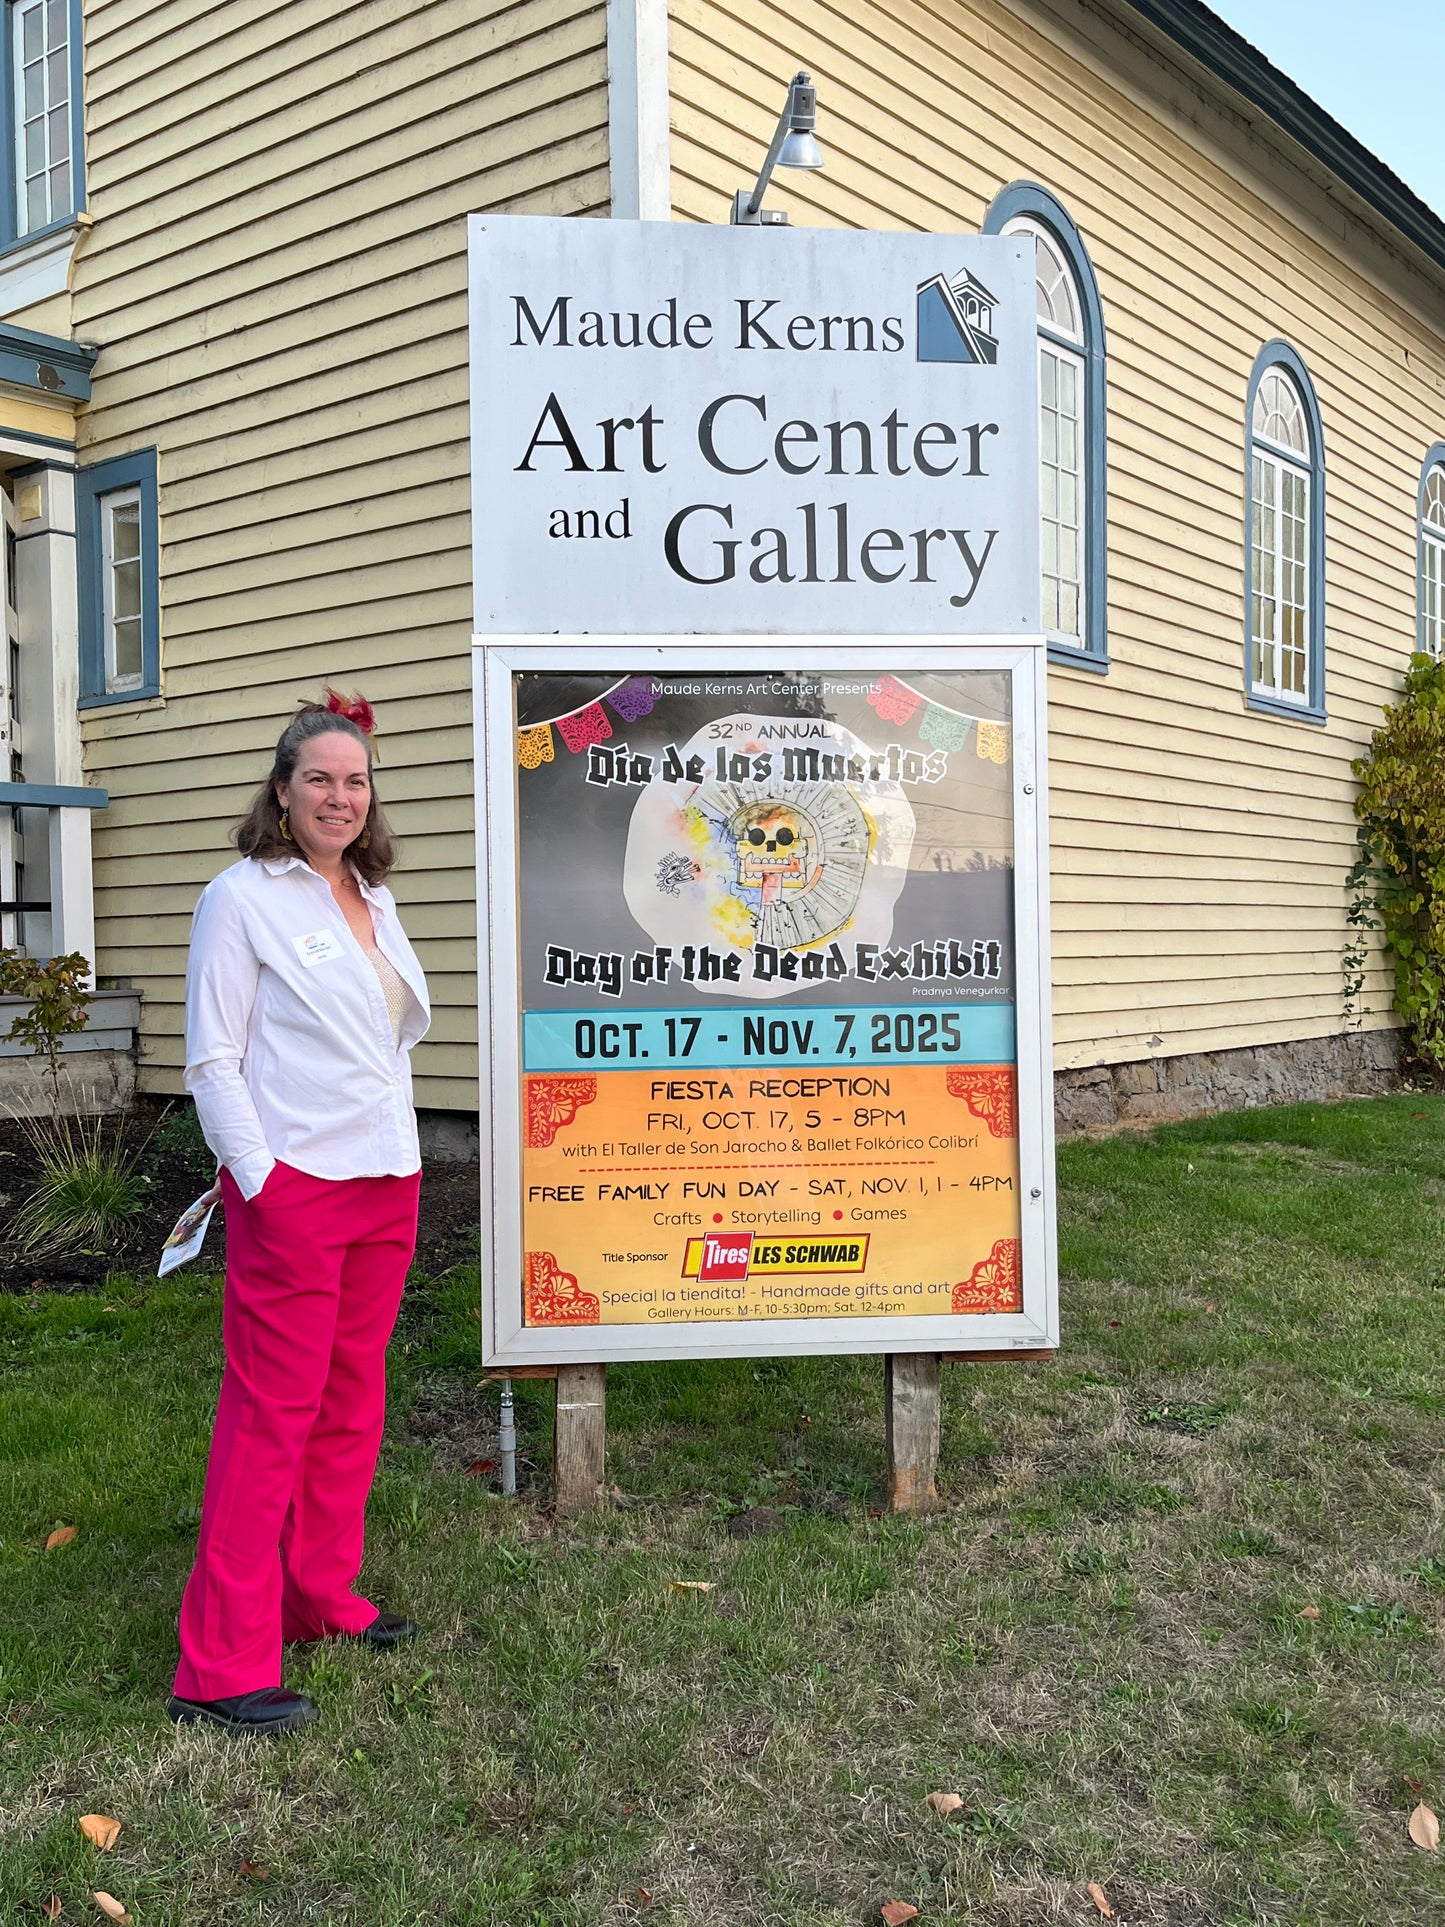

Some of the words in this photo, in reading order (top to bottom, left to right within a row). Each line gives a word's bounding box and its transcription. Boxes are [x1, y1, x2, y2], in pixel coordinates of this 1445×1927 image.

[509, 294, 714, 351] Maude
[734, 299, 905, 353] Kerns
[513, 391, 667, 474] Art
[698, 393, 999, 477] Center
[548, 497, 633, 540] and
[664, 502, 999, 608] Gallery
[651, 682, 701, 695] Maude
[705, 682, 743, 695] Kerns
[746, 682, 767, 695] Art
[771, 682, 819, 695] Center
[823, 682, 882, 695] Presents
[757, 723, 831, 739] ANNUAL
[585, 743, 653, 787] Día
[662, 743, 706, 786] de
[715, 745, 772, 784] los
[782, 743, 948, 785] Muertos
[544, 943, 624, 998] Day
[681, 945, 742, 984] the
[752, 942, 847, 984] Dead
[854, 937, 1002, 983] Exhibit
[912, 986, 952, 998] Pradnya
[954, 985, 1010, 997] Venegurkar
[665, 1018, 702, 1056] 17
[834, 1015, 857, 1058] 7,
[871, 1013, 961, 1053] 2025
[651, 1080, 734, 1100] FIESTA
[750, 1077, 890, 1099] RECEPTION
[769, 1110, 794, 1133] 17,
[804, 1110, 821, 1128] 5
[853, 1108, 906, 1127] 8PM
[562, 1143, 597, 1157] with
[602, 1143, 614, 1156] El
[618, 1142, 662, 1156] Taller
[665, 1141, 686, 1155] de
[690, 1141, 719, 1154] Son
[723, 1140, 787, 1153] Jarocho
[791, 1140, 803, 1152] &
[807, 1138, 851, 1151] Ballet
[856, 1136, 924, 1150] Folkórico
[928, 1134, 979, 1149] Colibrí
[529, 1185, 585, 1202] FREE
[598, 1182, 670, 1201] FAMILY
[683, 1182, 726, 1198] FUN
[739, 1180, 780, 1197] DAY
[969, 1175, 1013, 1191] 4PM
[653, 1212, 702, 1226] Crafts
[731, 1209, 821, 1225] Storytelling
[851, 1207, 907, 1220] Games
[602, 1252, 625, 1263] Title
[627, 1251, 668, 1264] Sponsor
[706, 1239, 748, 1269] Tires
[753, 1246, 782, 1264] LES
[785, 1244, 860, 1263] SCHWAB
[602, 1290, 659, 1304] Special
[662, 1289, 676, 1302] la
[680, 1287, 746, 1301] tiendita!
[761, 1285, 850, 1298] Handmade
[855, 1283, 888, 1299] gifts
[892, 1282, 923, 1295] and
[927, 1281, 950, 1294] art
[648, 1307, 693, 1320] Gallery
[694, 1305, 735, 1317] Hours:
[765, 1303, 831, 1315] 10-5:30pm;
[834, 1302, 857, 1313] Sat.
[861, 1301, 905, 1313] 12-4pm
